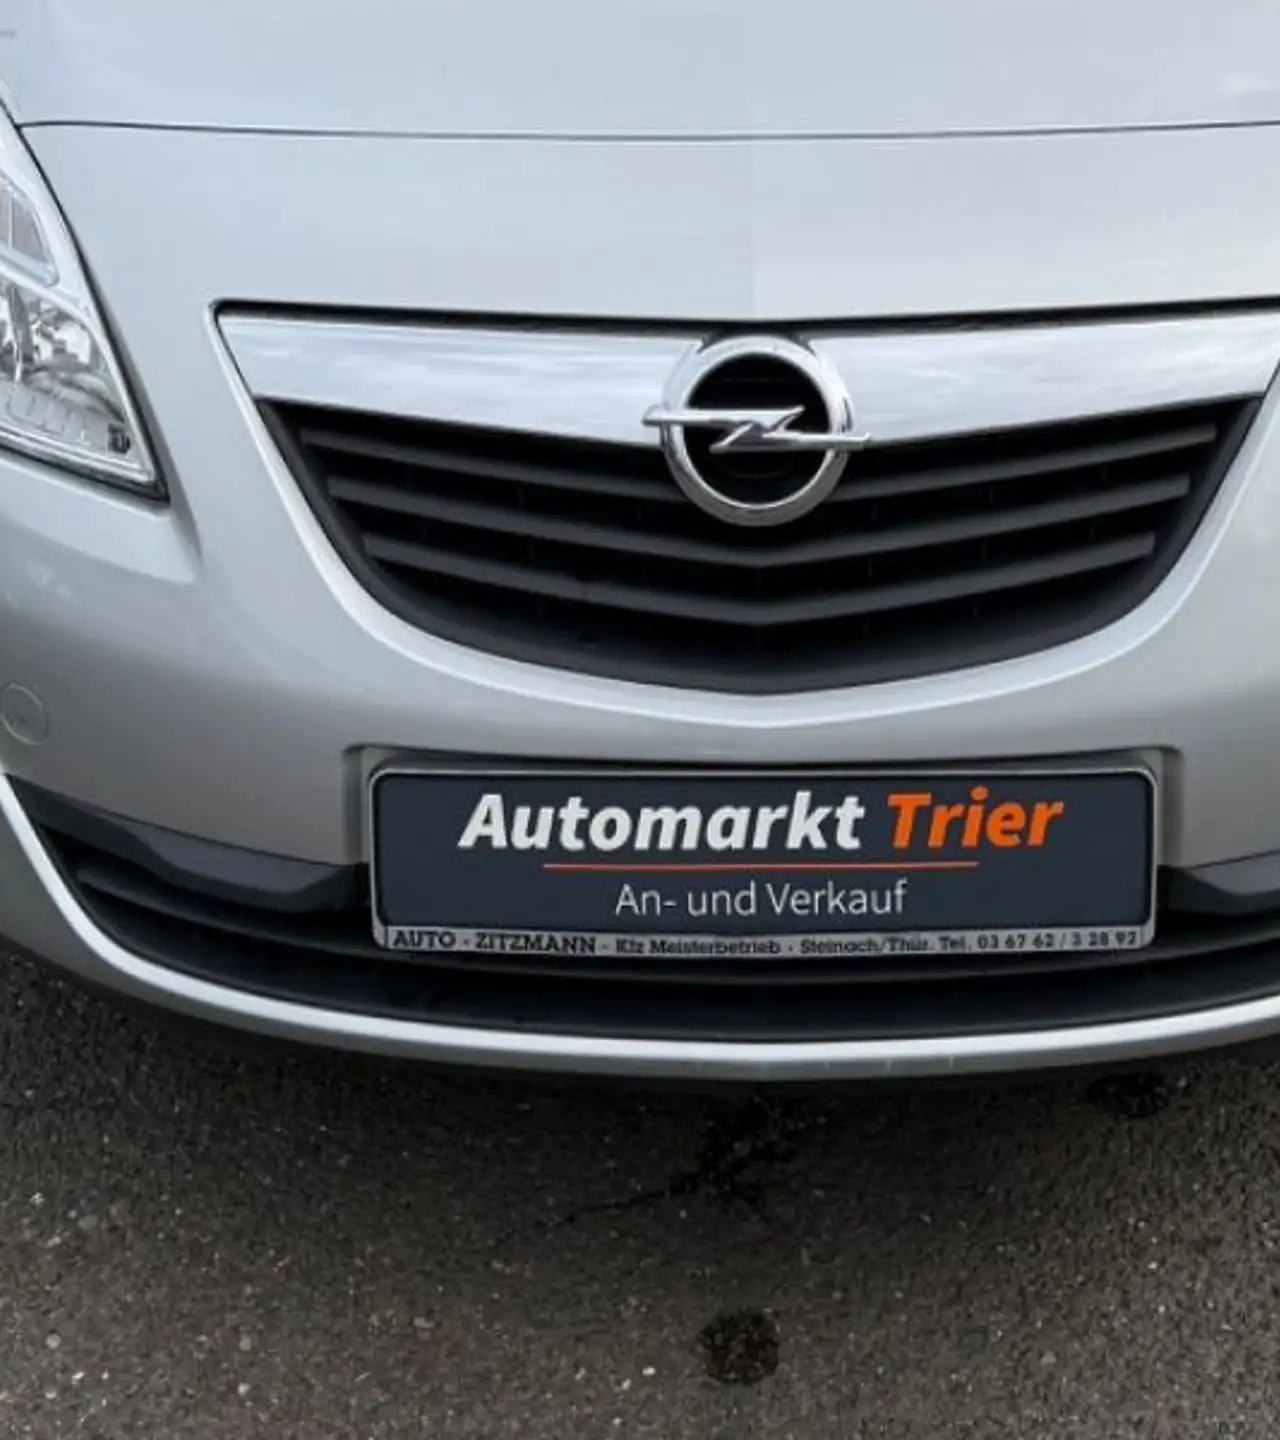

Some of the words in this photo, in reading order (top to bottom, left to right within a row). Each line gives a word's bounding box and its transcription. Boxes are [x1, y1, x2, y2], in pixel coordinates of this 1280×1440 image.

[458, 791, 866, 851] Automarkt
[886, 786, 1065, 849] Trier
[615, 882, 677, 916] An-
[687, 879, 758, 916] und
[766, 877, 909, 916] Verkauf
[393, 931, 456, 949] AUTO
[475, 932, 596, 956] ZITZMANN
[650, 938, 781, 955] Meisterbetrieb
